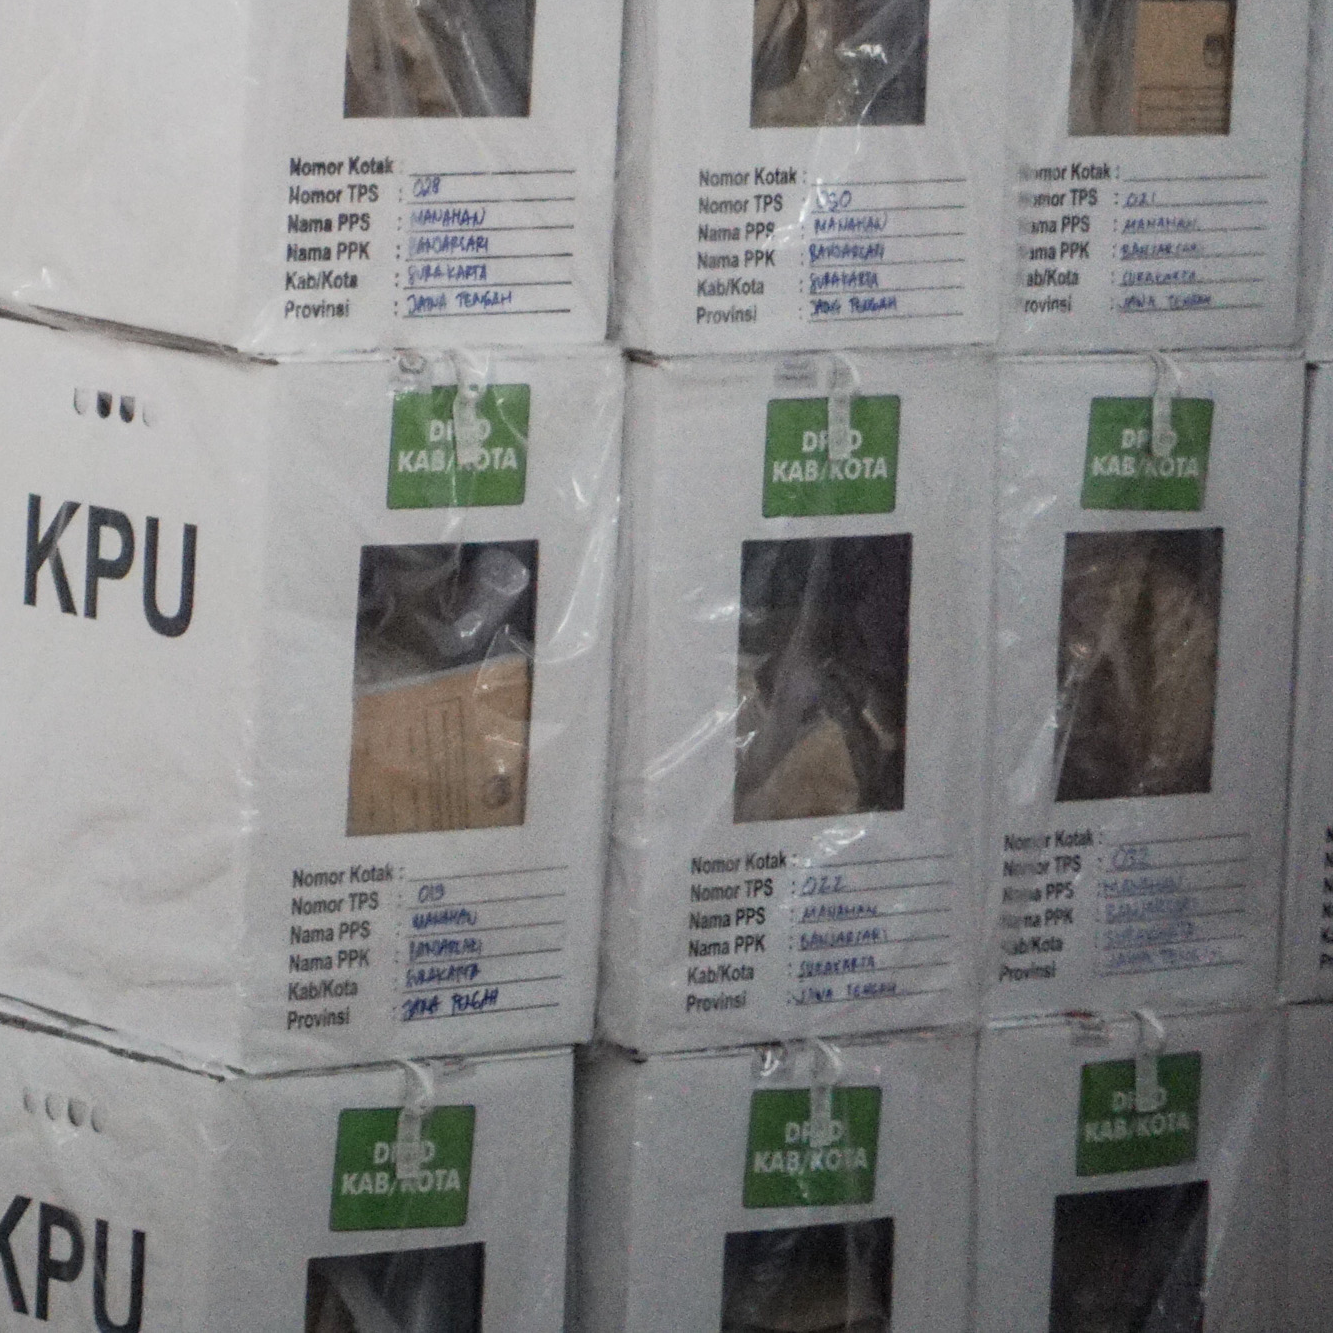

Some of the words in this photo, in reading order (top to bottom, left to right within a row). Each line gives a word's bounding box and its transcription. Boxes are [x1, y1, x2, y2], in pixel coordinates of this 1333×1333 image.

[289, 157, 344, 177] Nomor
[348, 156, 394, 175] Kotak
[698, 169, 750, 187] Nomor
[754, 167, 797, 186] Kotak
[1070, 162, 1111, 181] Kotak
[288, 186, 343, 205] Nomor
[348, 184, 380, 203] TPS
[698, 196, 749, 214] Nomor
[754, 193, 783, 213] TPS
[1070, 188, 1098, 206] TPS
[287, 215, 332, 234] Nama
[338, 213, 371, 232] PPS
[698, 224, 740, 242] Nama
[745, 222, 775, 241] PPS
[1061, 214, 1090, 233] PPS
[286, 243, 332, 262] Nama
[336, 242, 370, 260] PPK
[697, 252, 739, 269] Nama
[744, 250, 776, 267] PPK
[1060, 240, 1090, 260] PPK
[285, 271, 358, 291] Kab/Kota
[697, 278, 765, 297] Kab/Kota
[284, 299, 350, 319] Provinsi
[696, 306, 757, 324] Provinsi
[801, 428, 863, 453] DPD
[772, 456, 888, 483] KAB/KOTA
[23, 493, 198, 638] KPU
[690, 856, 741, 875] Nomor
[745, 850, 787, 871] Kotak
[292, 868, 344, 888] Nomor
[349, 863, 394, 884] Kotak
[690, 883, 740, 902] Nomor
[744, 877, 774, 898] TPS
[291, 896, 344, 916] Nomor
[348, 891, 380, 911] TPS
[688, 912, 731, 930] Nama
[735, 907, 766, 925] PPS
[289, 925, 333, 945] Nama
[338, 920, 371, 940] PPS
[688, 938, 730, 957] Nama
[734, 934, 766, 953] PPK
[289, 953, 332, 973] Nama
[337, 949, 370, 969] PPK
[687, 965, 755, 986] Kab/Kota
[288, 980, 358, 1002] Kab/Kota
[686, 991, 747, 1013] Provinsi
[287, 1007, 351, 1030] Provinsi
[753, 1147, 868, 1175] KAB/KOTA
[341, 1168, 461, 1197] KAB/KOTA
